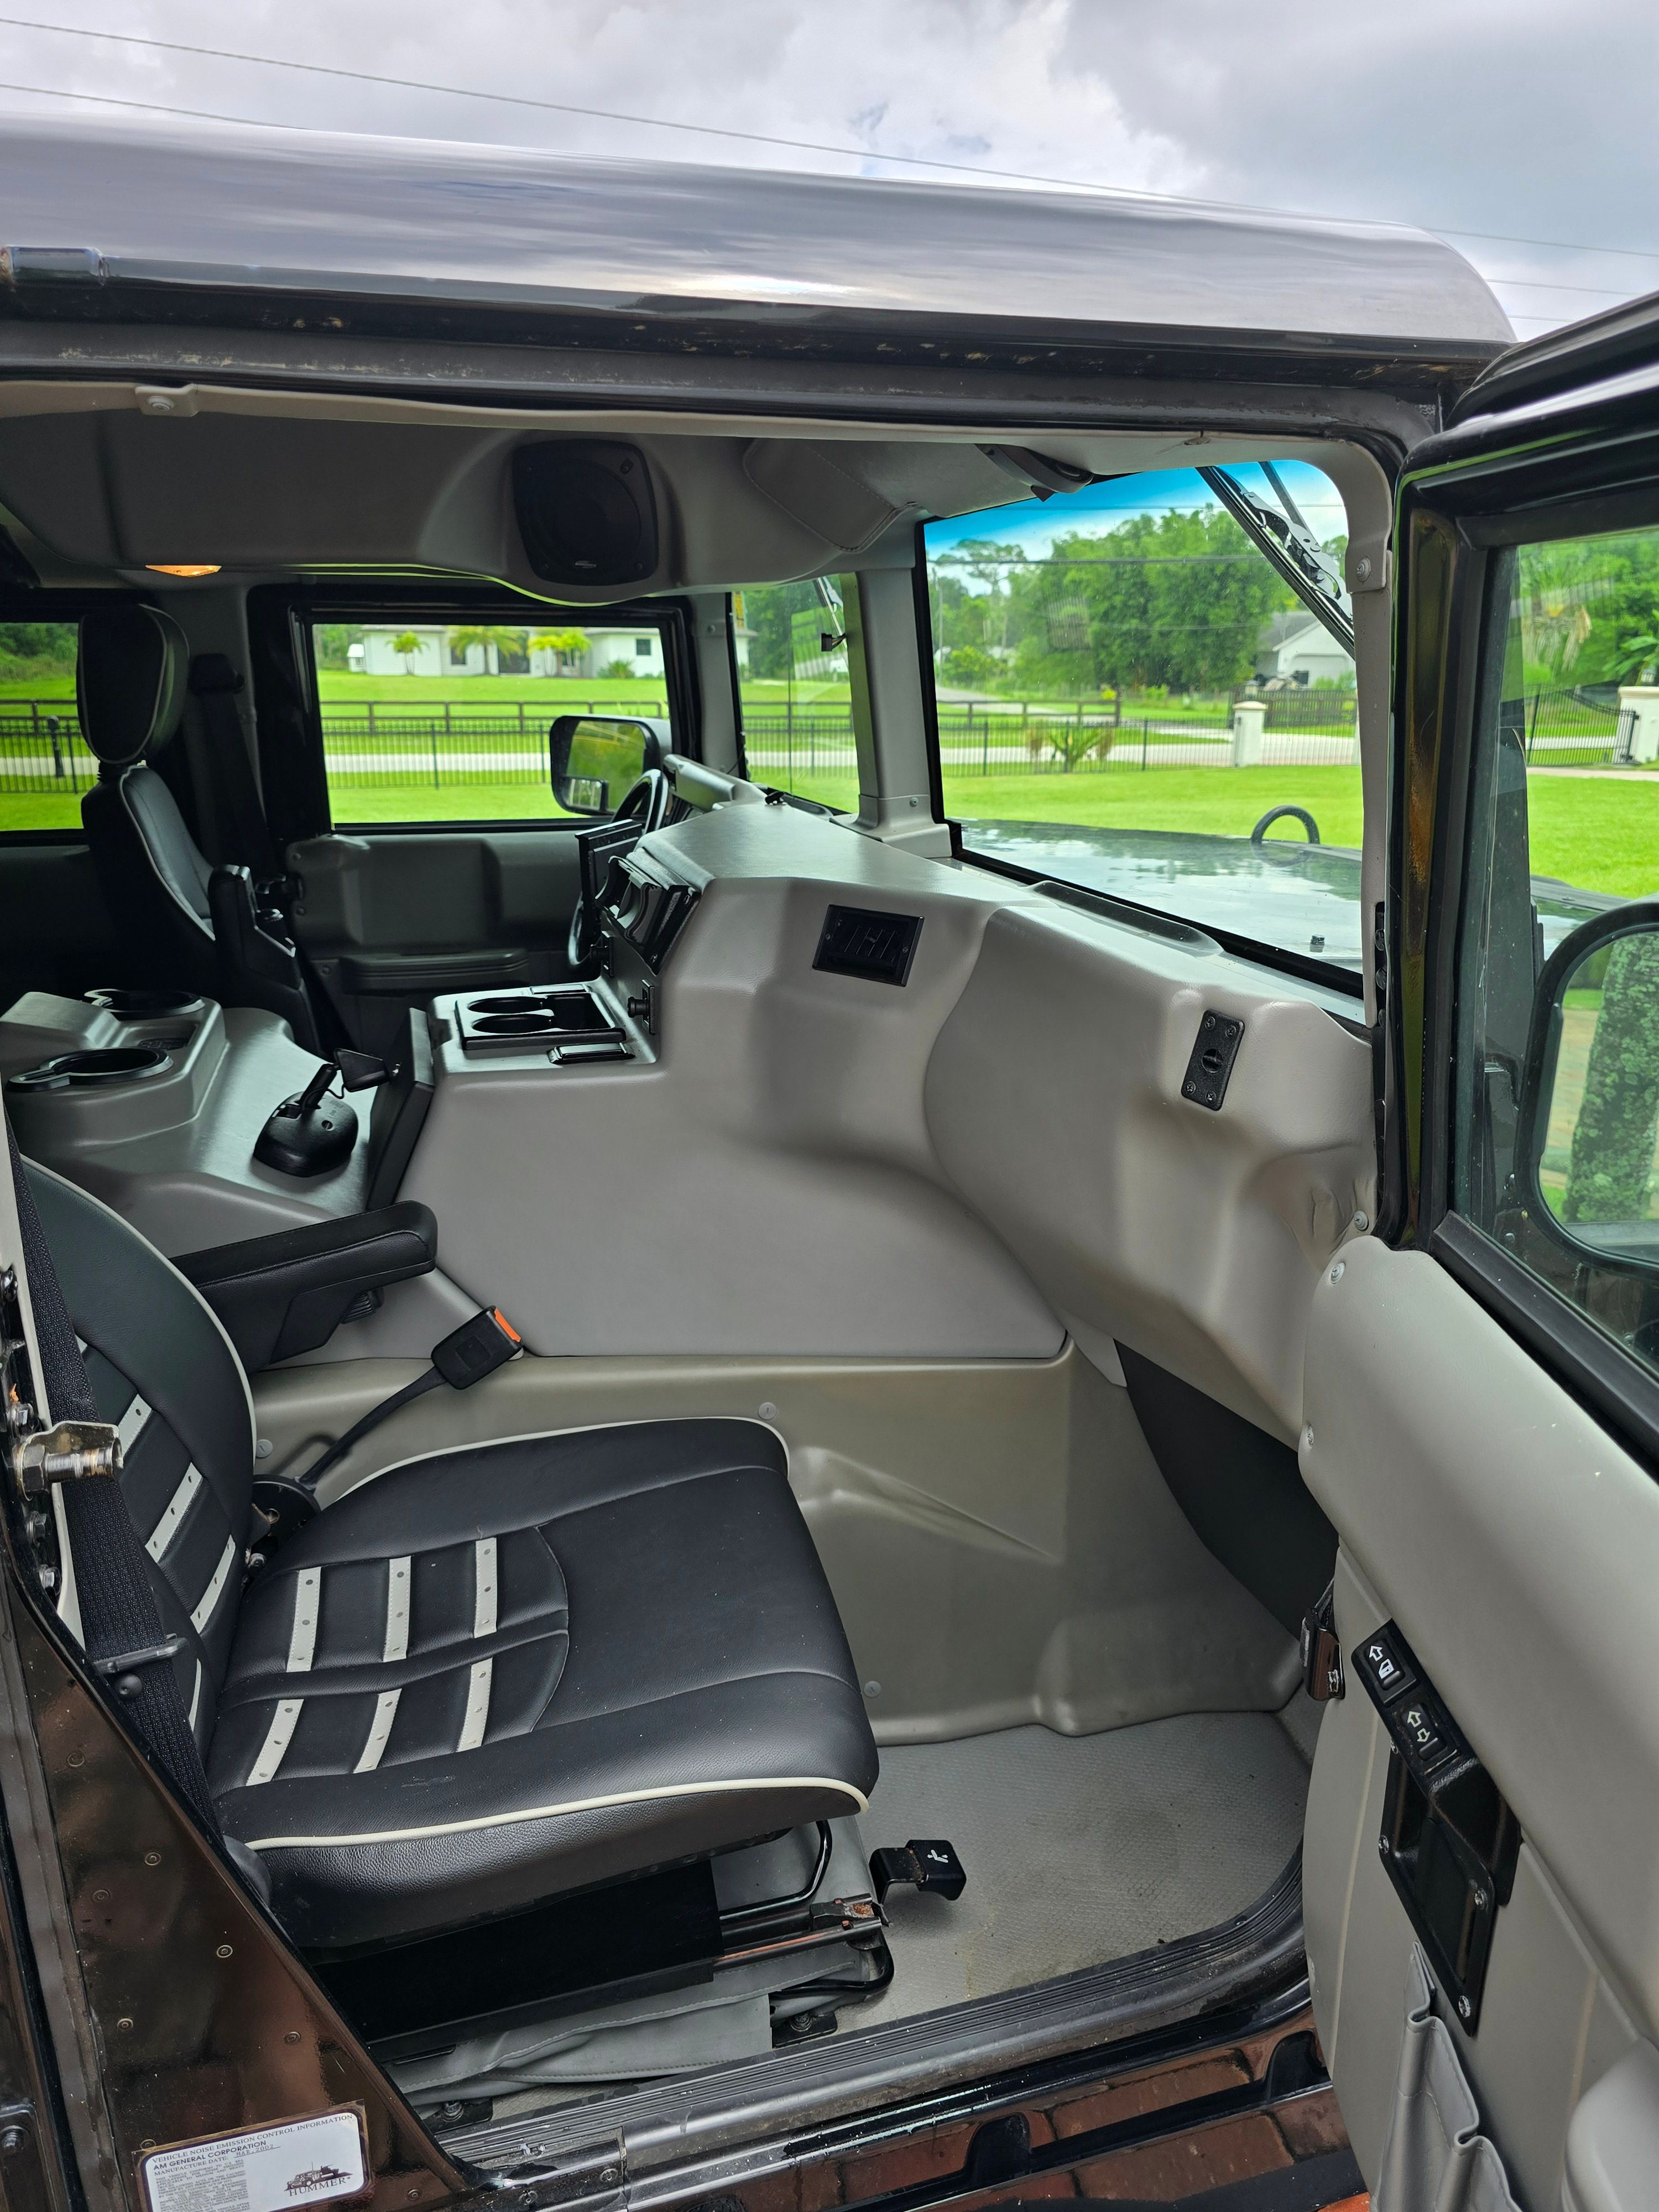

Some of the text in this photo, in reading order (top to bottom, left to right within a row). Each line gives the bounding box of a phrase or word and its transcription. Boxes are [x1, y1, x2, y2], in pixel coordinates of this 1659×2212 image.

[152, 2114, 353, 2163] VEHICLE NOISE EMISSION CONTROL INFORMATION
[169, 2154, 206, 2167] GENERAL
[208, 2140, 267, 2158] CORPORATION
[154, 2160, 207, 2176] MANUFACTURE
[208, 2156, 228, 2164] DATE:
[156, 2178, 183, 2187] APPLICABLE
[289, 2177, 347, 2197] HUMMER
